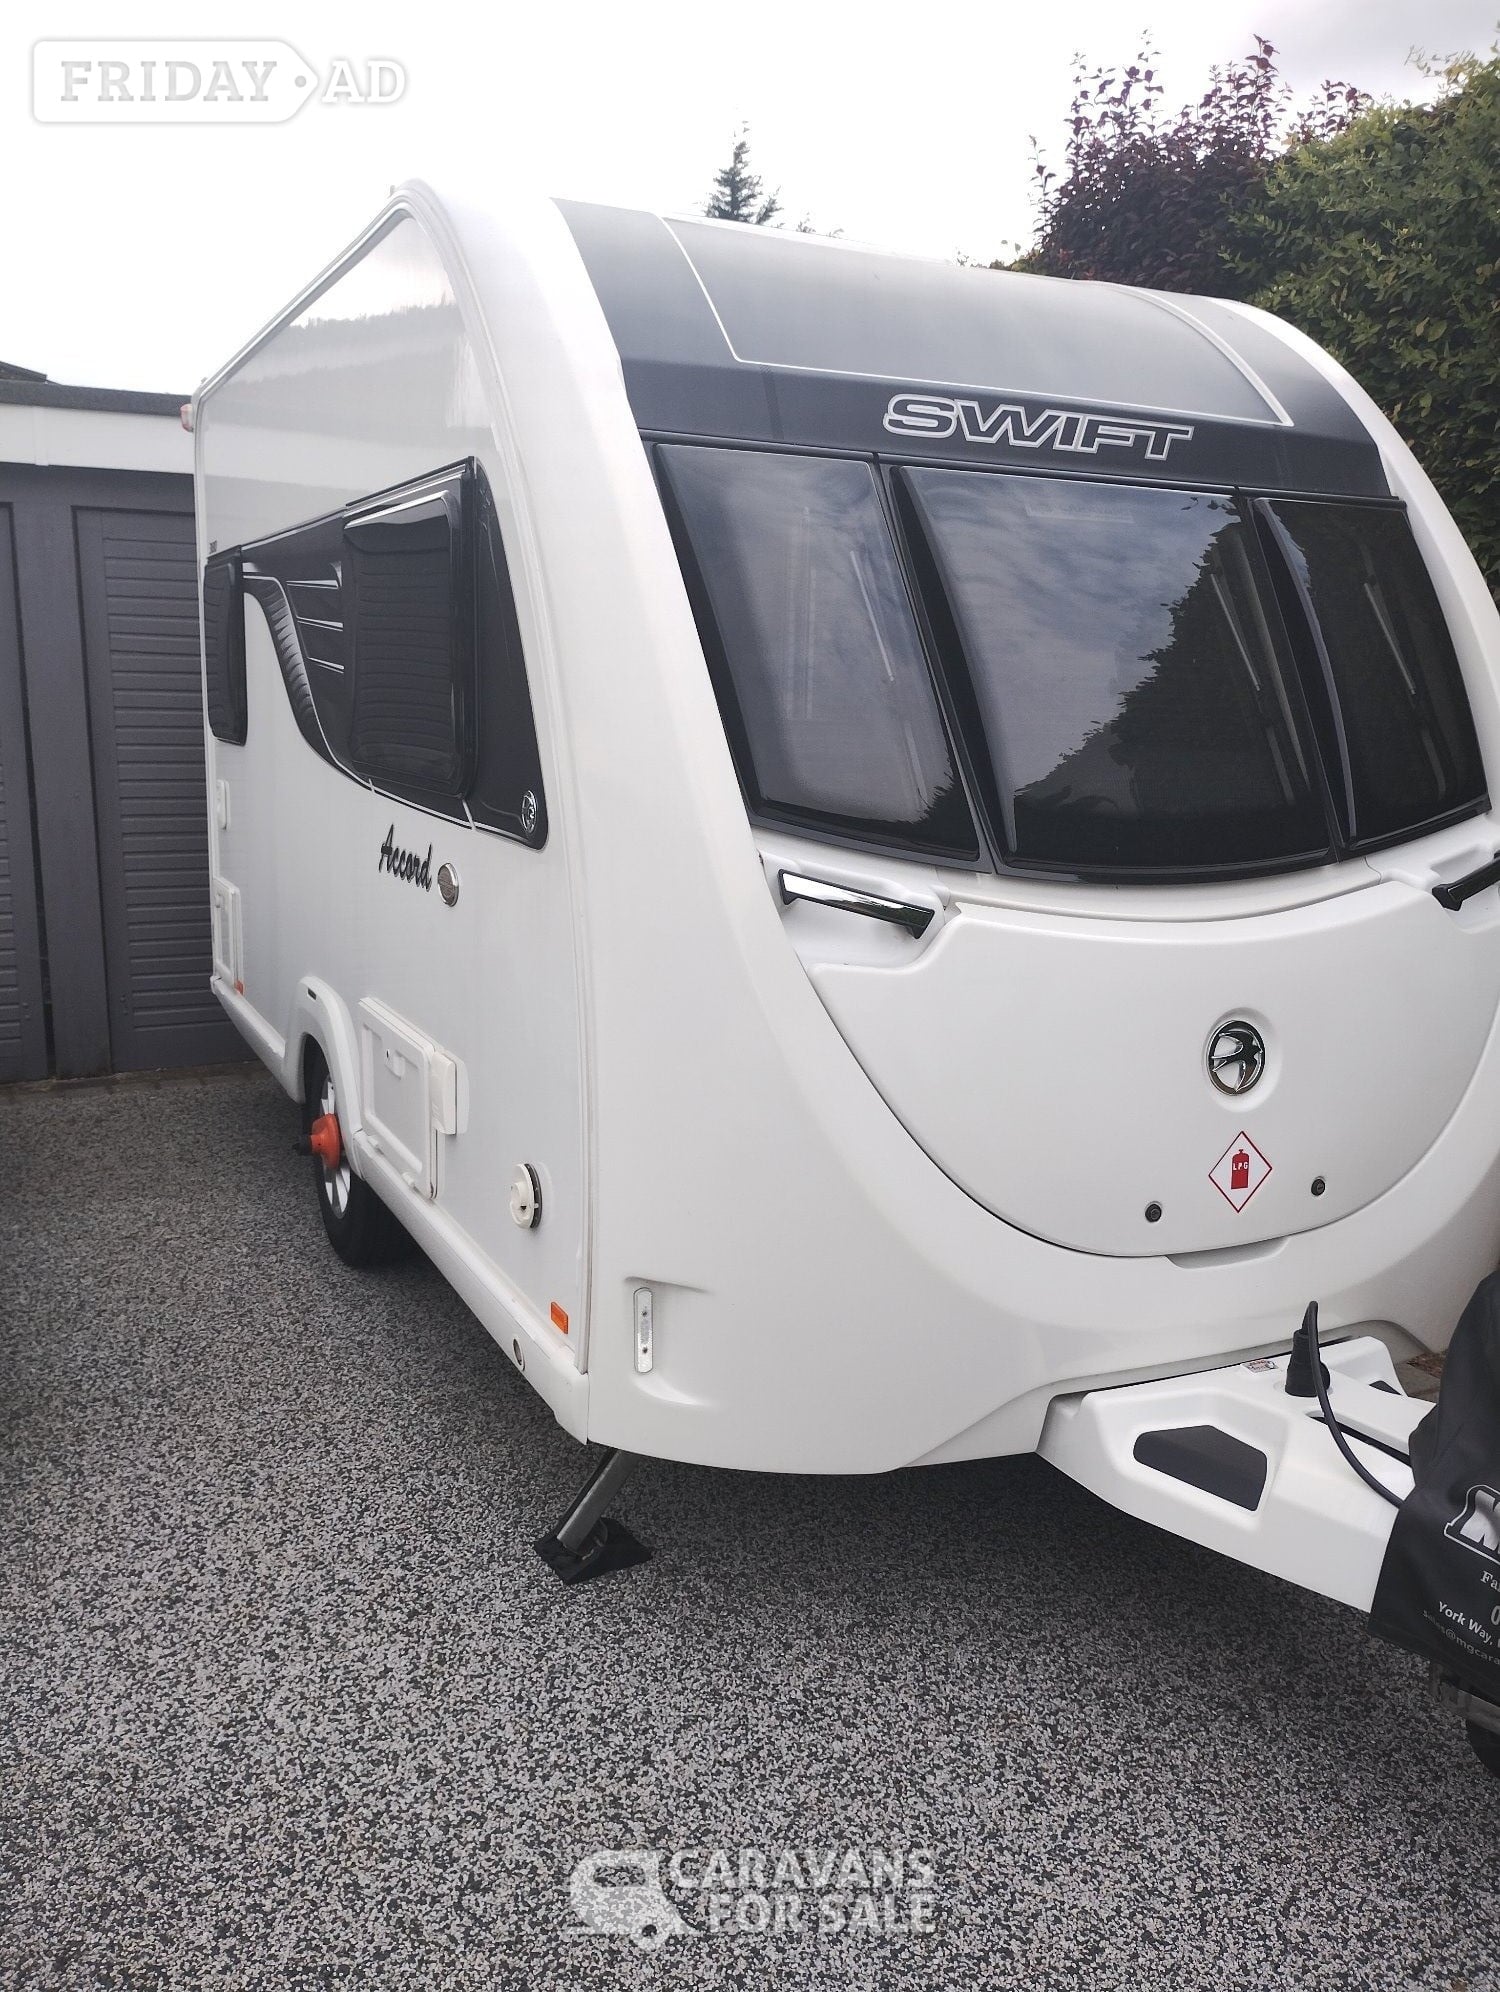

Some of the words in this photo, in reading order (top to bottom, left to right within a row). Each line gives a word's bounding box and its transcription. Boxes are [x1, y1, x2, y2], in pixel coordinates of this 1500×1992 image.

[883, 393, 1195, 461] SWIFT
[378, 823, 433, 892] Accord
[1232, 1161, 1249, 1170] LPG
[1480, 1570, 1500, 1593] Fa
[1439, 1600, 1466, 1626] York
[1468, 1618, 1493, 1646] Way,
